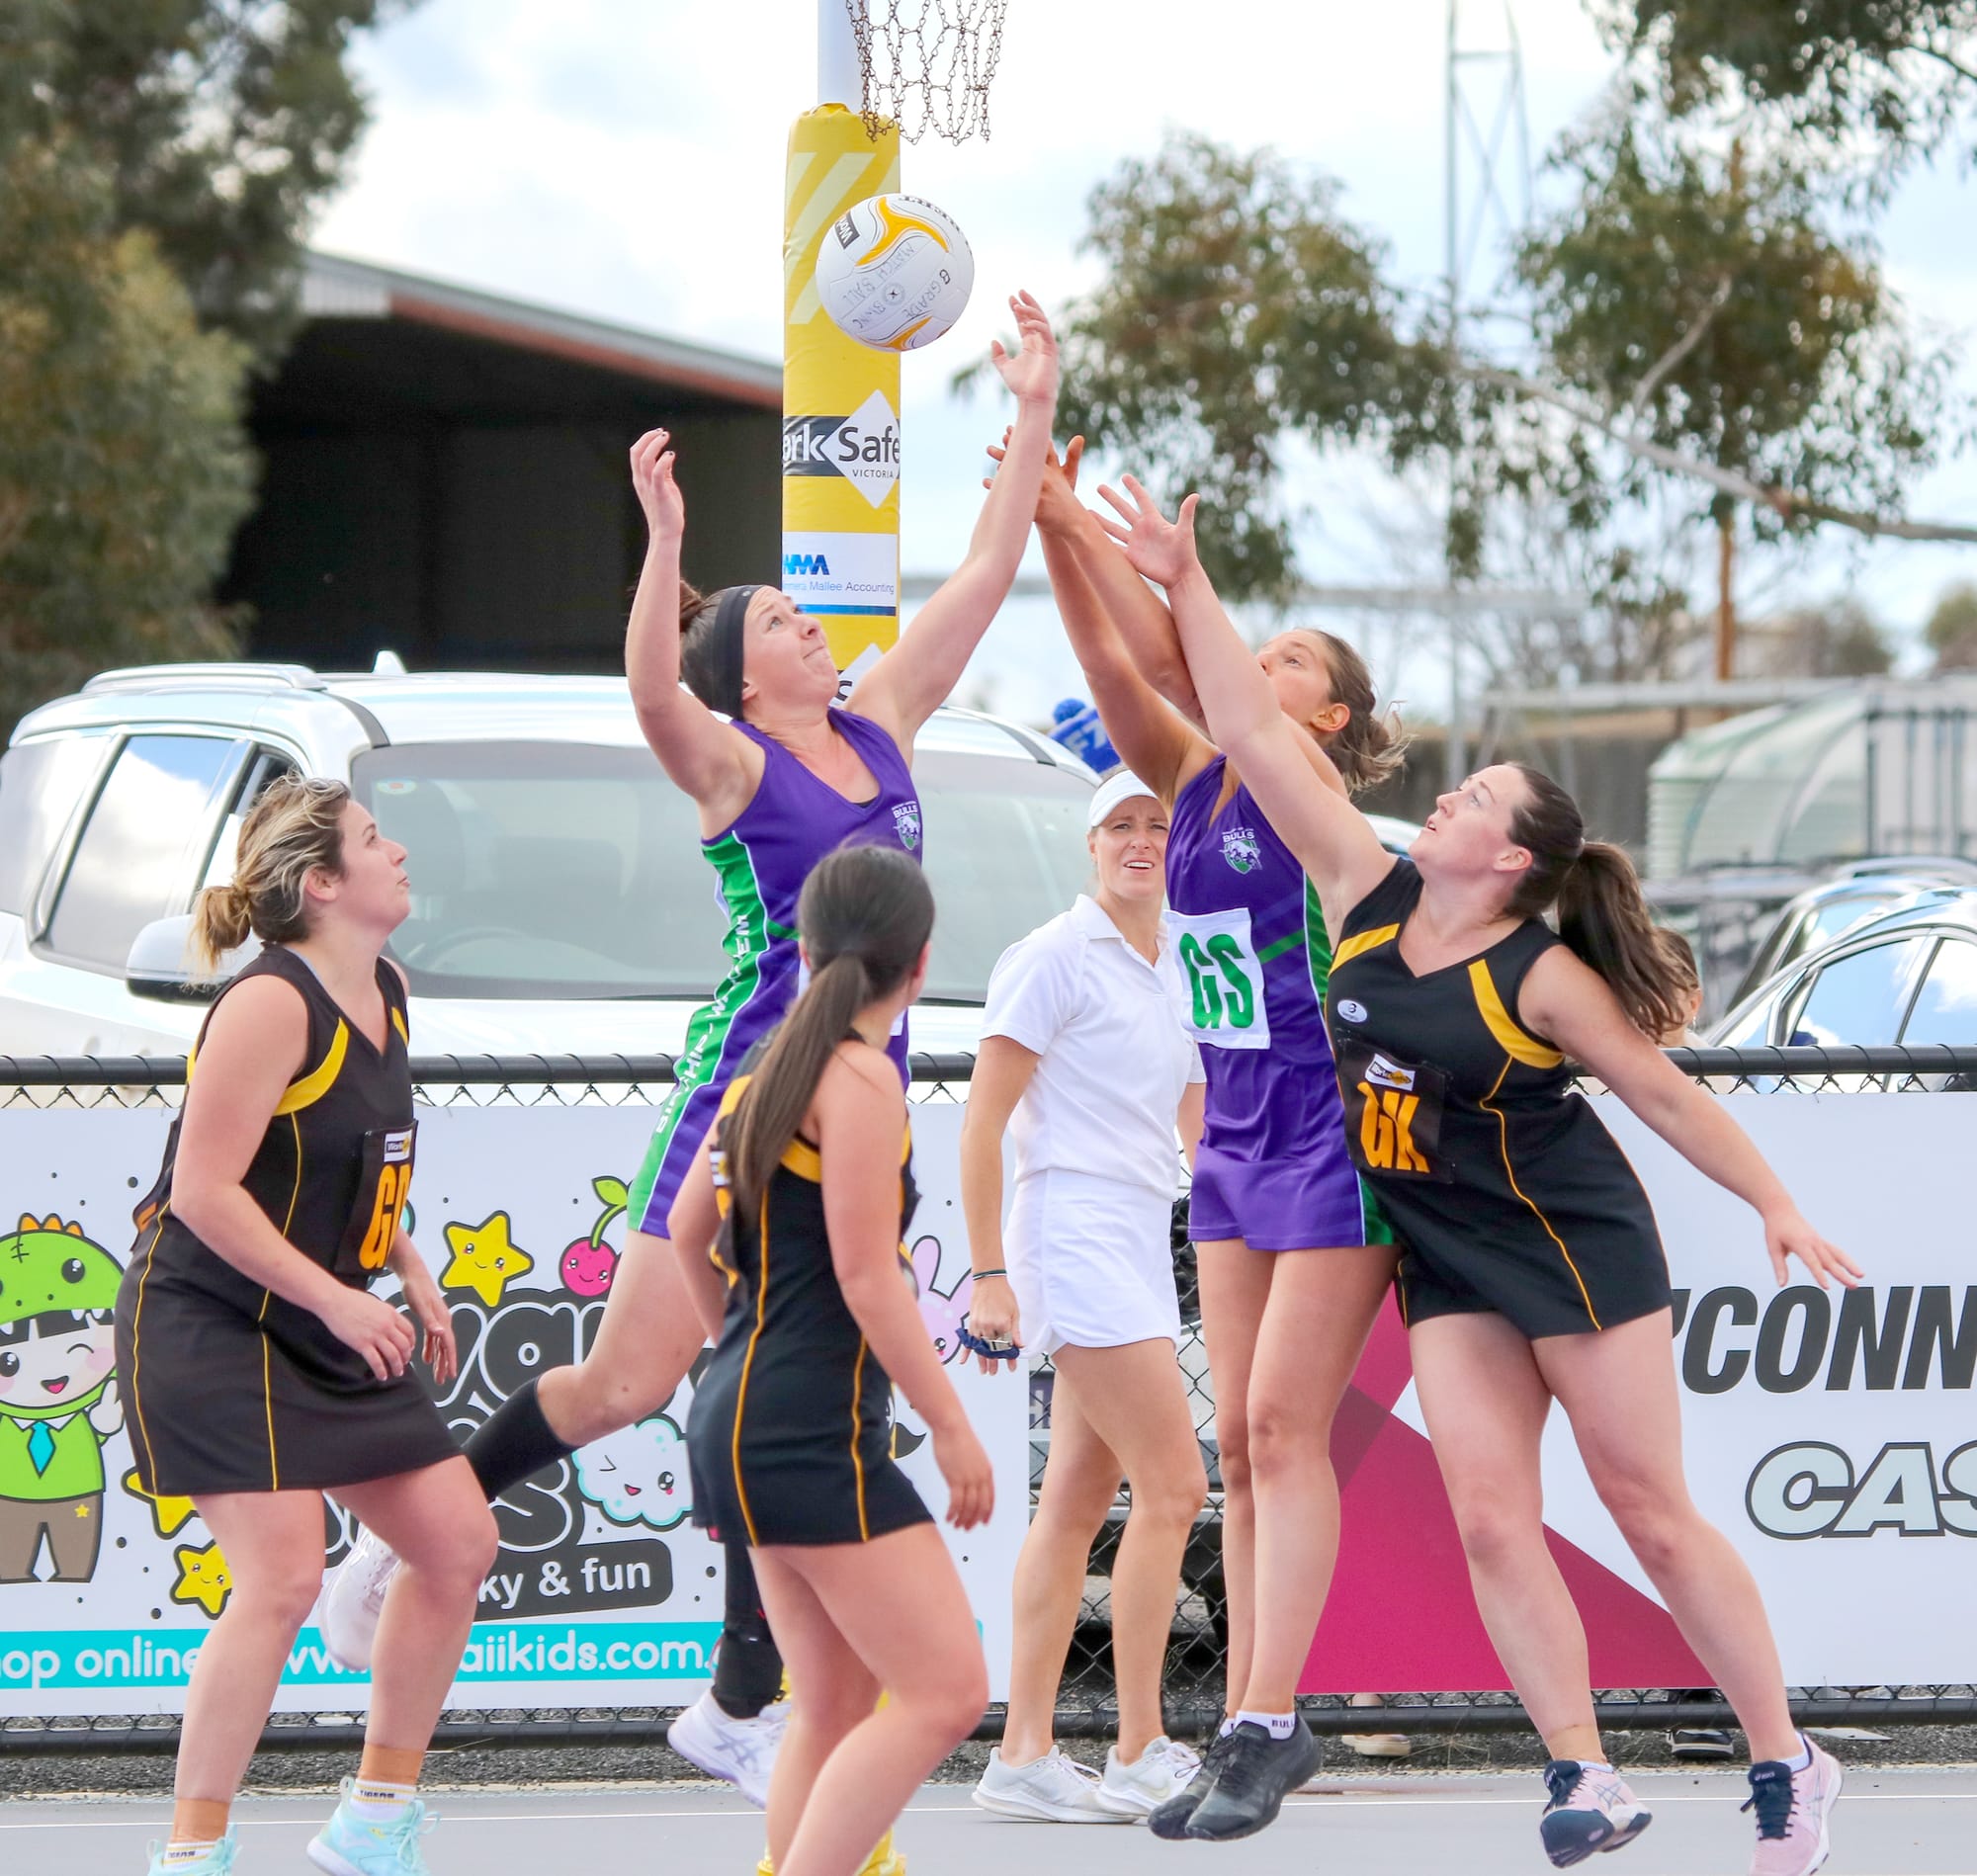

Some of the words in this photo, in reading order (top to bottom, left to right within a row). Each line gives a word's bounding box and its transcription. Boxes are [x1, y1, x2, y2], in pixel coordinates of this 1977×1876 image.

[838, 425, 901, 464] Safe
[852, 469, 895, 478] VICTORIA
[810, 580, 843, 592] Mallee
[845, 580, 895, 595] Accounting
[1222, 831, 1254, 843] BULLS
[1179, 932, 1255, 1030] GS
[1356, 1081, 1430, 1174] GK
[538, 1561, 571, 1597] &
[580, 1557, 651, 1593] fun
[0, 1649, 61, 1689] op
[74, 1635, 202, 1679] online
